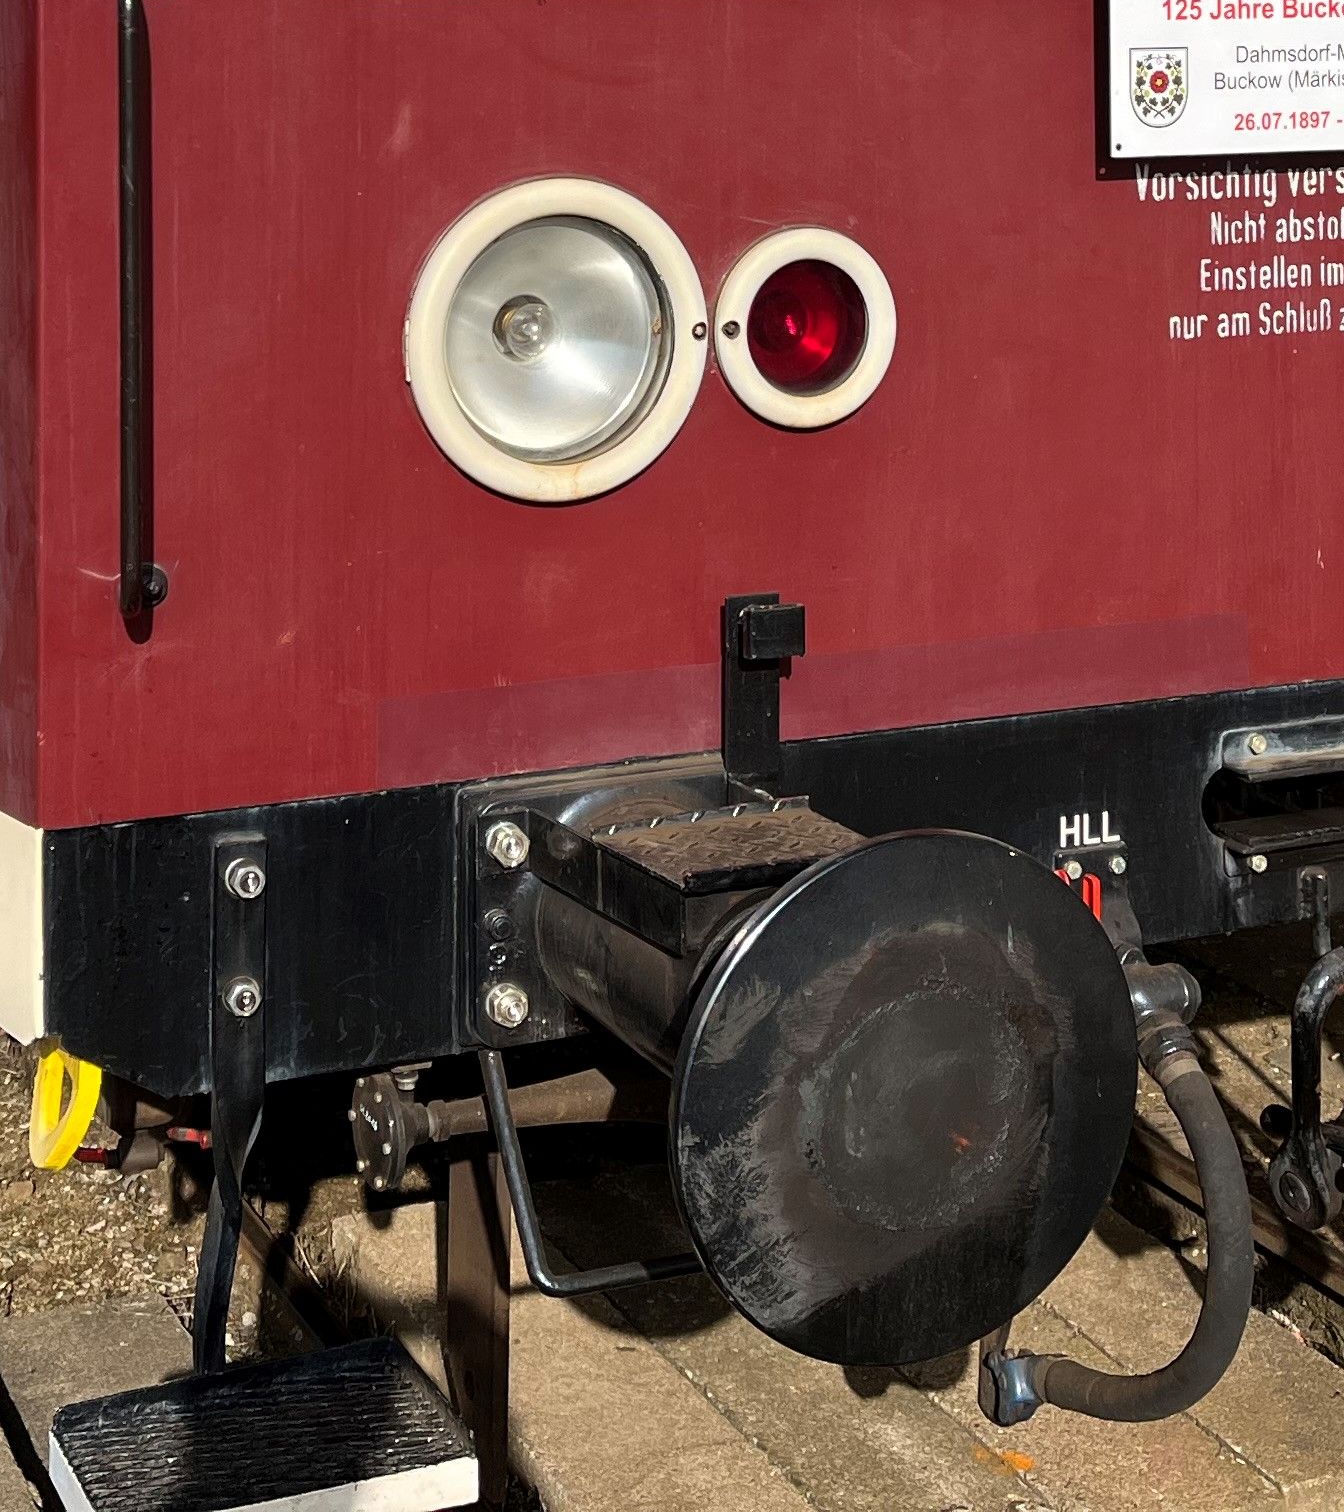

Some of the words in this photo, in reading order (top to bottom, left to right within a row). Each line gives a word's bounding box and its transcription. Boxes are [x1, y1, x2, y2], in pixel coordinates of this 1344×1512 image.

[1214, 71, 1282, 90] Buckow
[1234, 110, 1331, 131] 26.07.1897
[1135, 162, 1277, 207] Vorsichtig
[1211, 210, 1267, 245] Nicht
[1200, 255, 1311, 292] Einstellen
[1319, 256, 1344, 287] im
[1169, 313, 1208, 340] nur
[1217, 311, 1250, 338] am
[1258, 298, 1331, 336] Schluß
[1060, 810, 1121, 848] HLL
